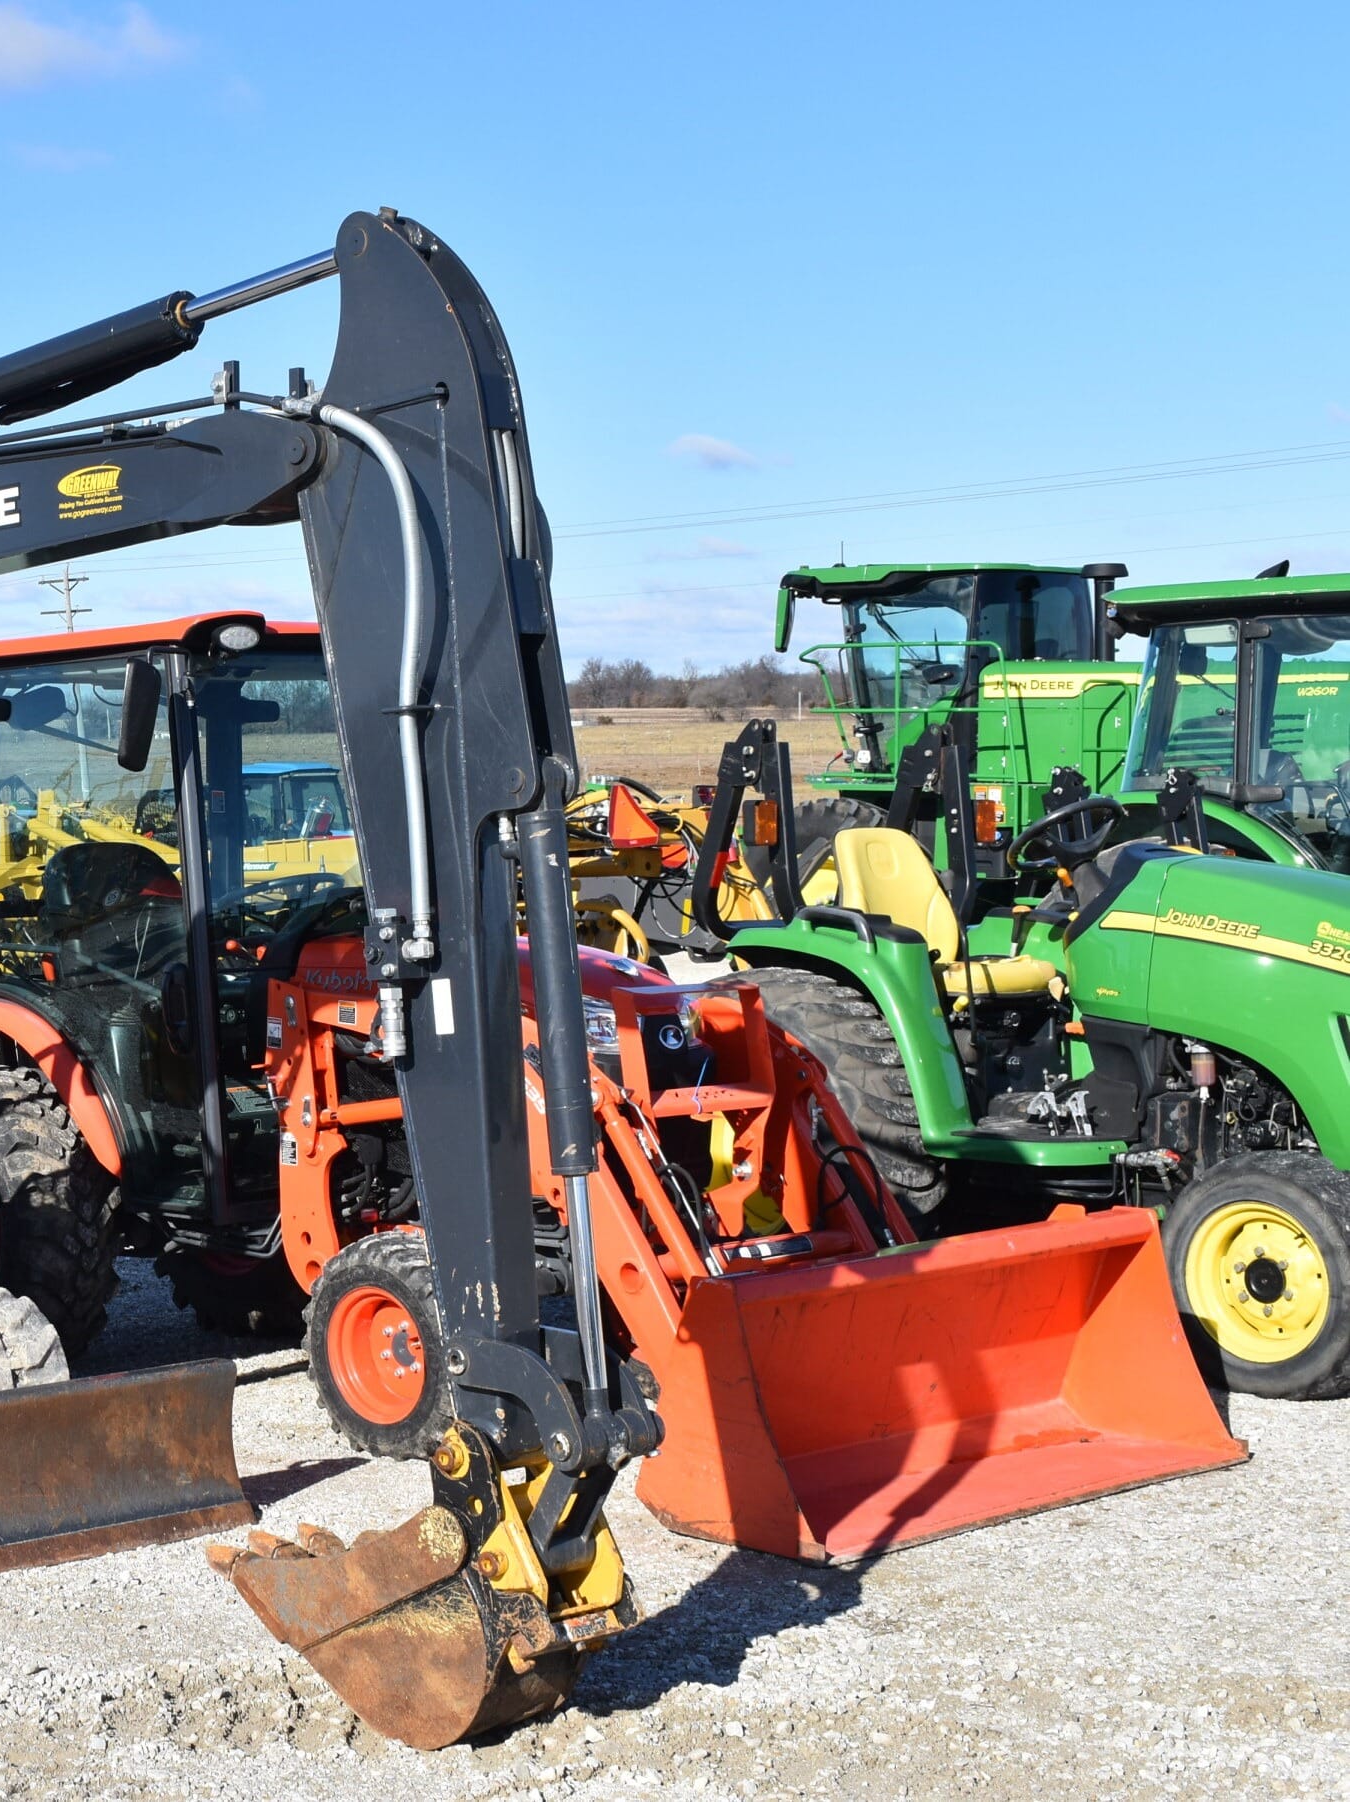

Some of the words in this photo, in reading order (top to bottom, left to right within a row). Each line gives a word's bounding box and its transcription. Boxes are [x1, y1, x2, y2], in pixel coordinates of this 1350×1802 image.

[65, 470, 120, 494] GREENWAY
[59, 504, 122, 519] www.gogreenway.com
[1030, 679, 1074, 690] DEERE
[1297, 686, 1339, 697] W260R
[1160, 907, 1203, 928] JOHN
[1202, 914, 1260, 938] DEERE
[306, 966, 372, 992] Kubota
